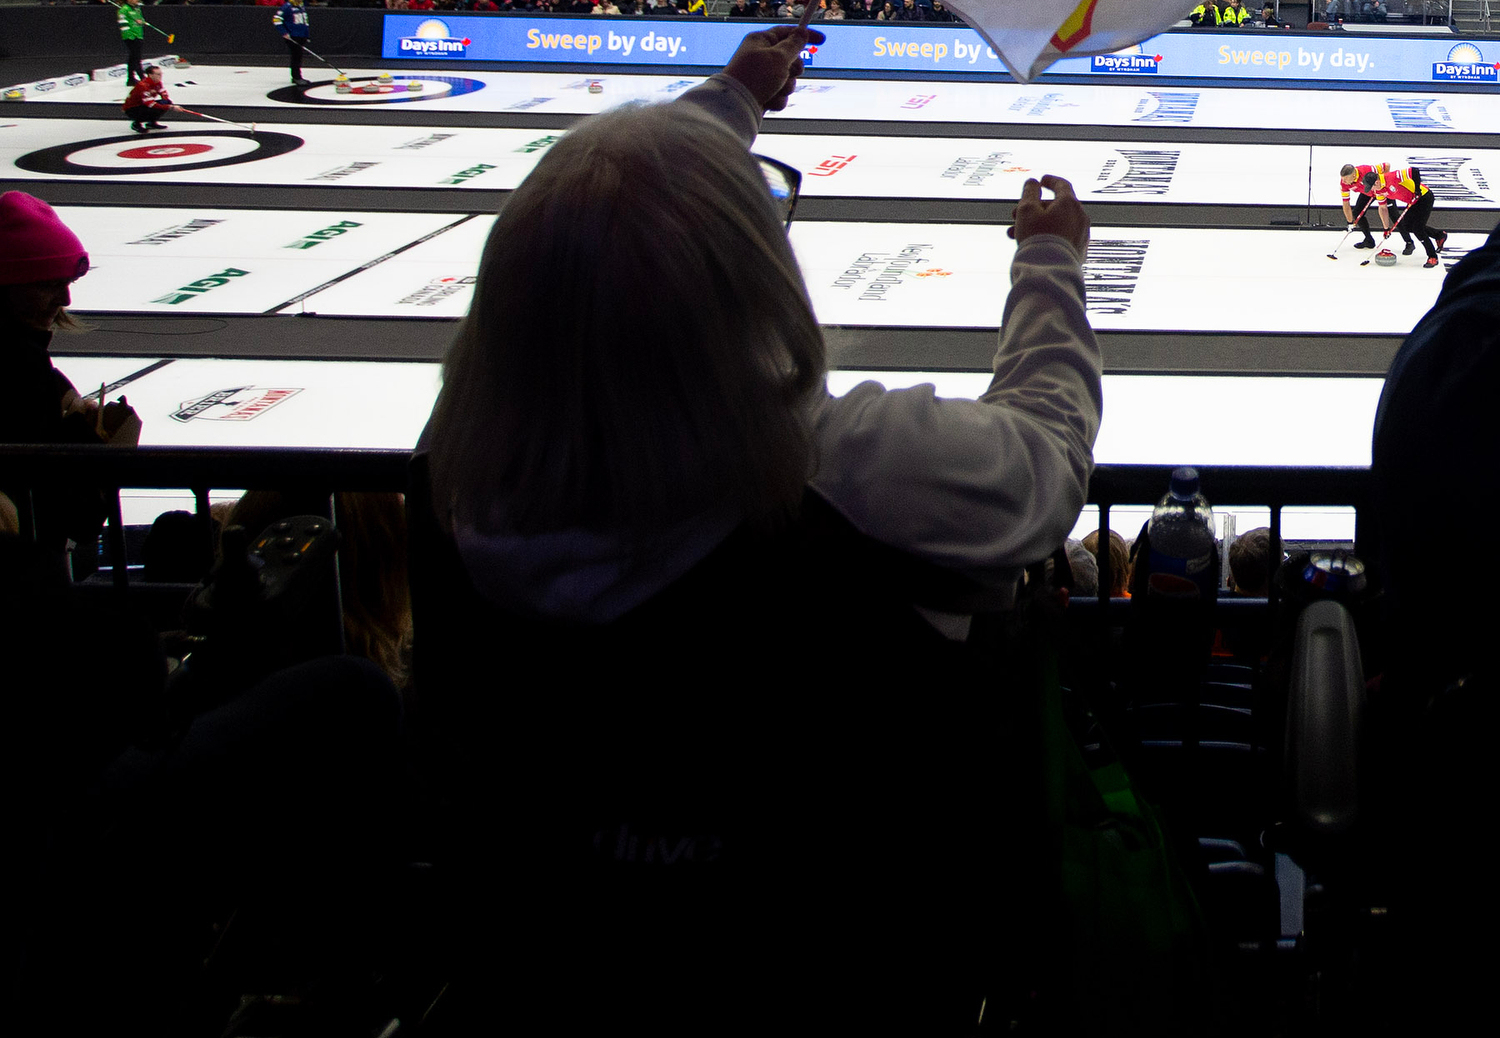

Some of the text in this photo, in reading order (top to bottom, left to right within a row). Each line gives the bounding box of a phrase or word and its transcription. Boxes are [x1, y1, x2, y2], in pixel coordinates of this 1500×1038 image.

[401, 39, 464, 52] Days Inn
[526, 28, 687, 57] Sweep by day.
[873, 36, 948, 61] Sweep
[954, 39, 980, 64] by
[1095, 56, 1156, 69] Days Inn
[1218, 45, 1375, 73] Sweep by day.
[1436, 63, 1495, 77] Days Inn
[807, 154, 858, 177] TSN
[962, 151, 1012, 187] Newfoundland
[1090, 148, 1181, 195] MONTANA'S
[303, 220, 364, 240] AGI
[176, 267, 252, 293] AGI
[831, 252, 891, 290] Labrador
[858, 243, 934, 302] Newfoundland
